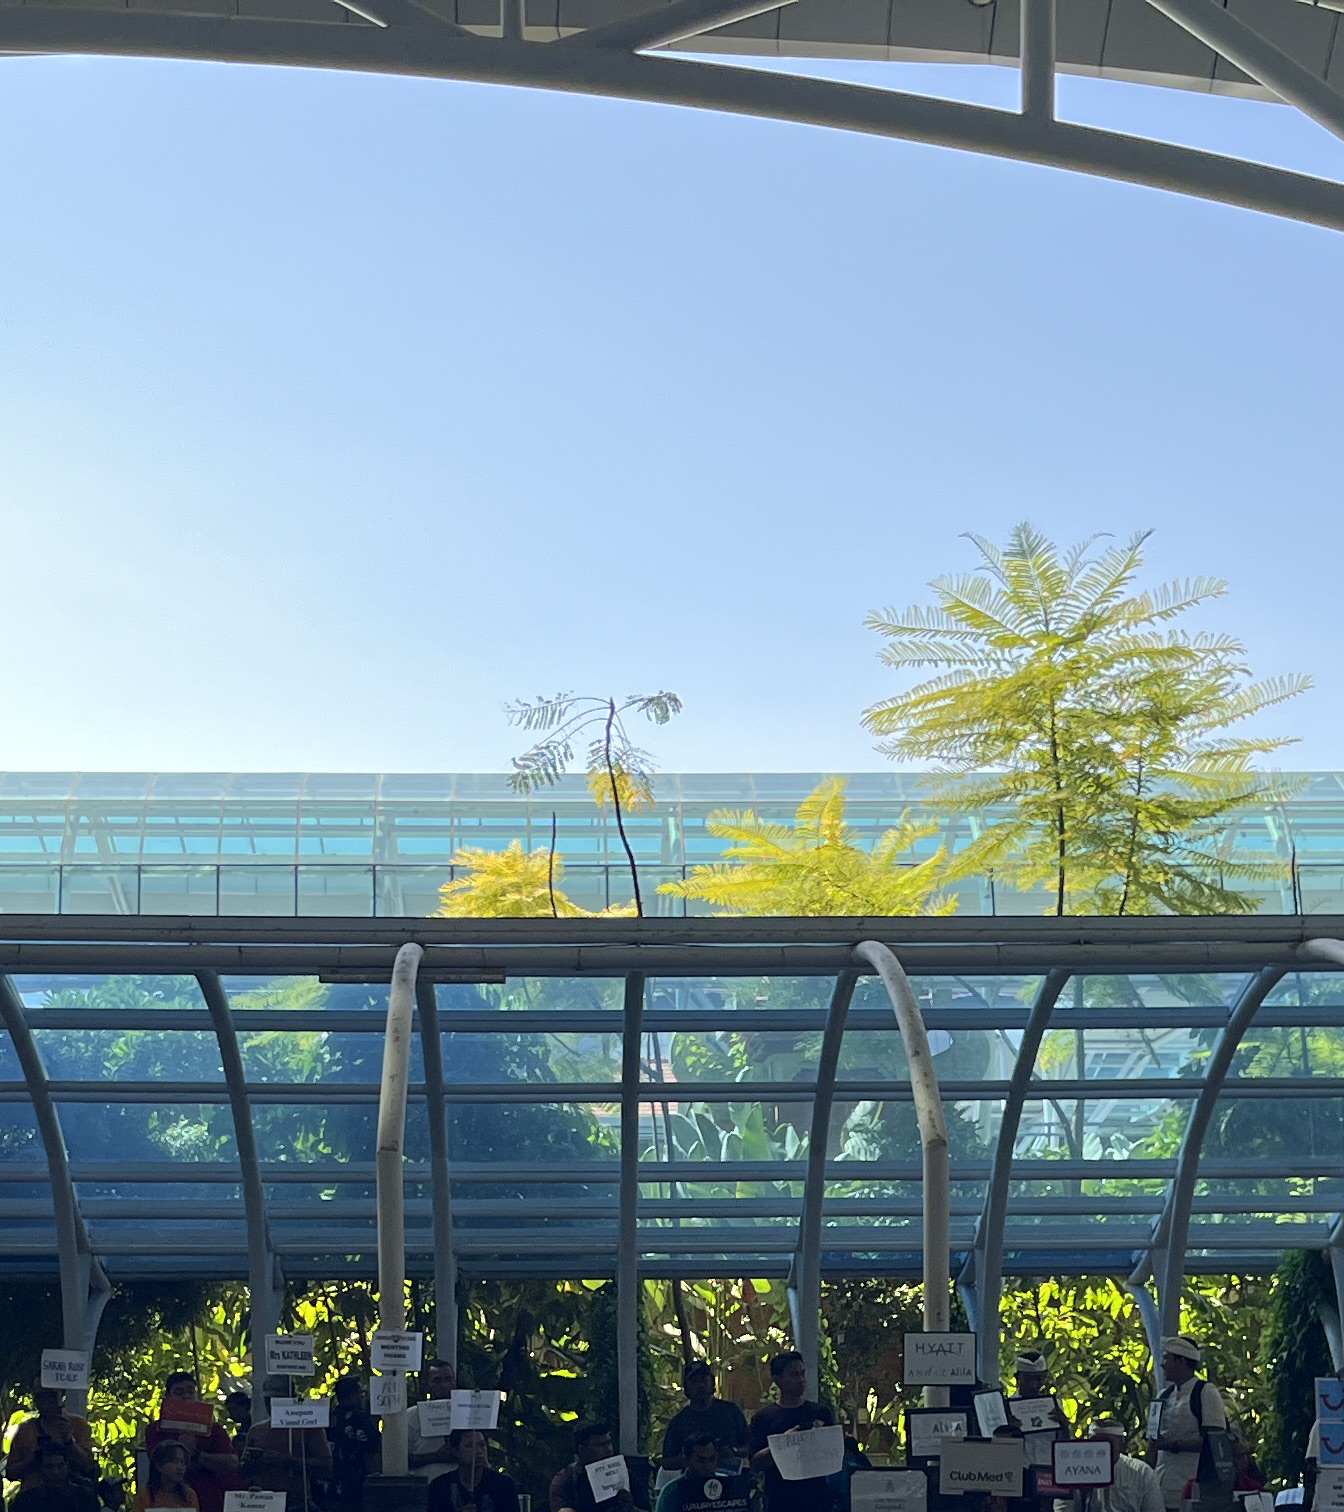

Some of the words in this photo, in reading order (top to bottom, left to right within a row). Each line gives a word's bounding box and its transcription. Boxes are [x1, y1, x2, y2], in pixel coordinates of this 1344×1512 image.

[915, 1342, 965, 1356] HYATT
[949, 1470, 977, 1482] Club
[977, 1471, 1004, 1482] Med
[1064, 1465, 1102, 1476] AYANA
